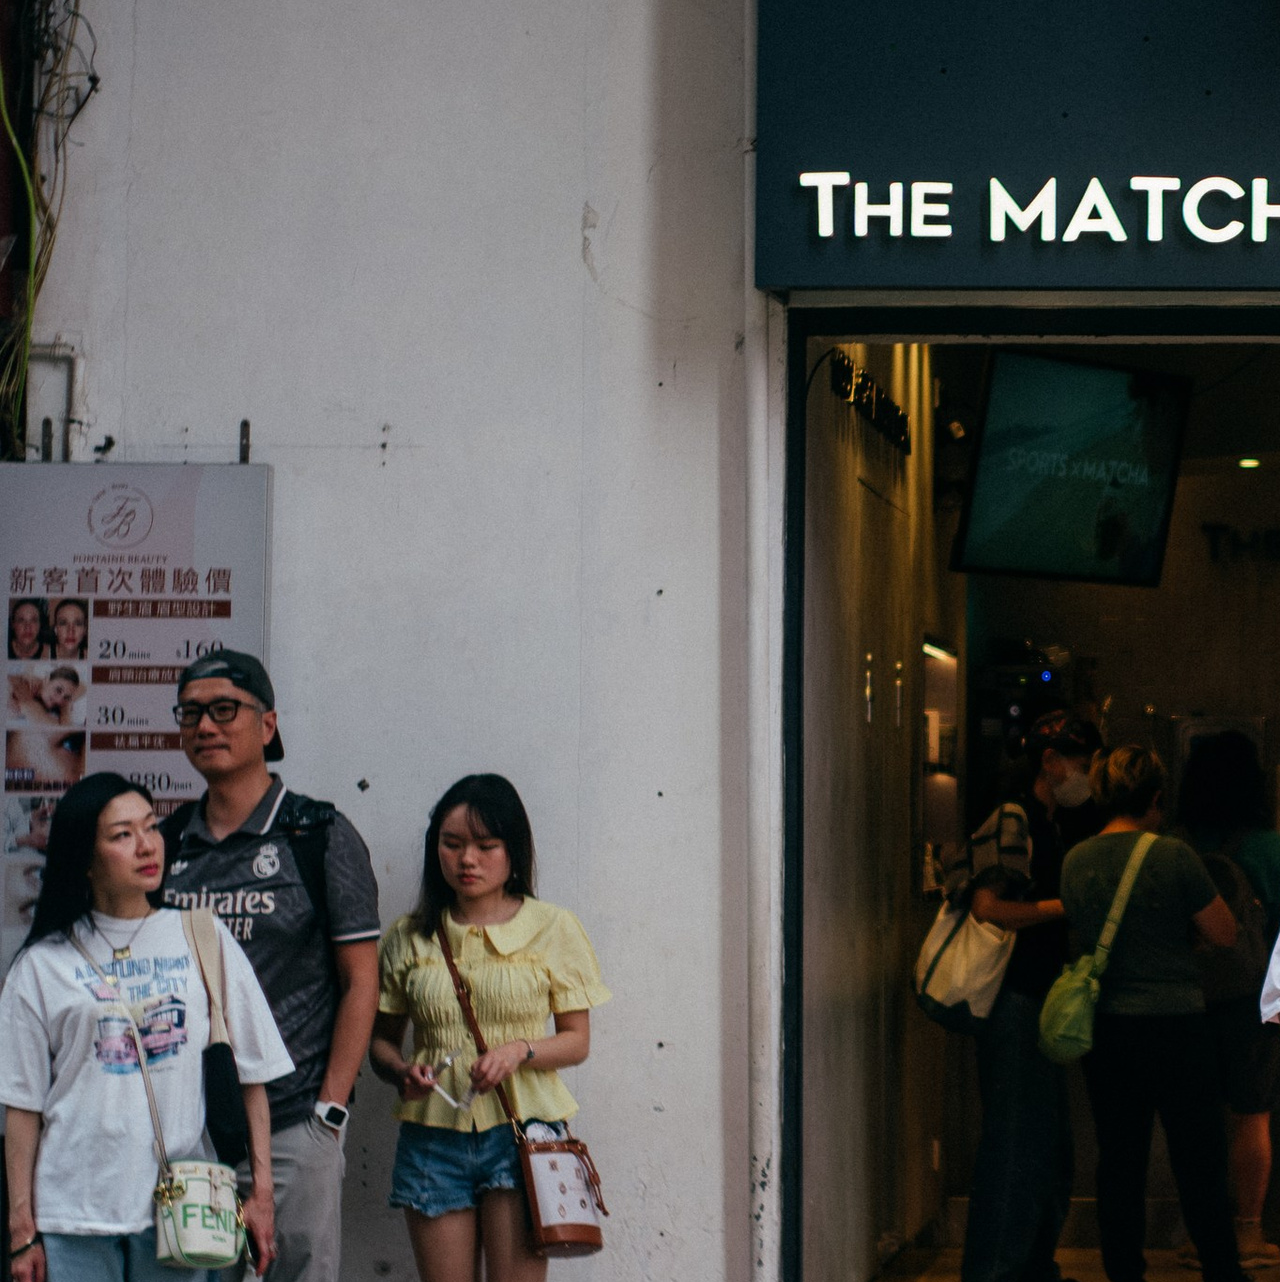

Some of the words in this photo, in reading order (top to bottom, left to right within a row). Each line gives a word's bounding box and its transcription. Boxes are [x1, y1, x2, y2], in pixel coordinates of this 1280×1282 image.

[800, 172, 953, 238] THE
[1083, 459, 1149, 486] MATCHA
[127, 554, 168, 564] BEAUTY
[10, 566, 232, 594] 新客首次體驗價
[99, 640, 127, 660] 20
[164, 885, 276, 915] Emirates
[182, 1203, 236, 1235] FEND
